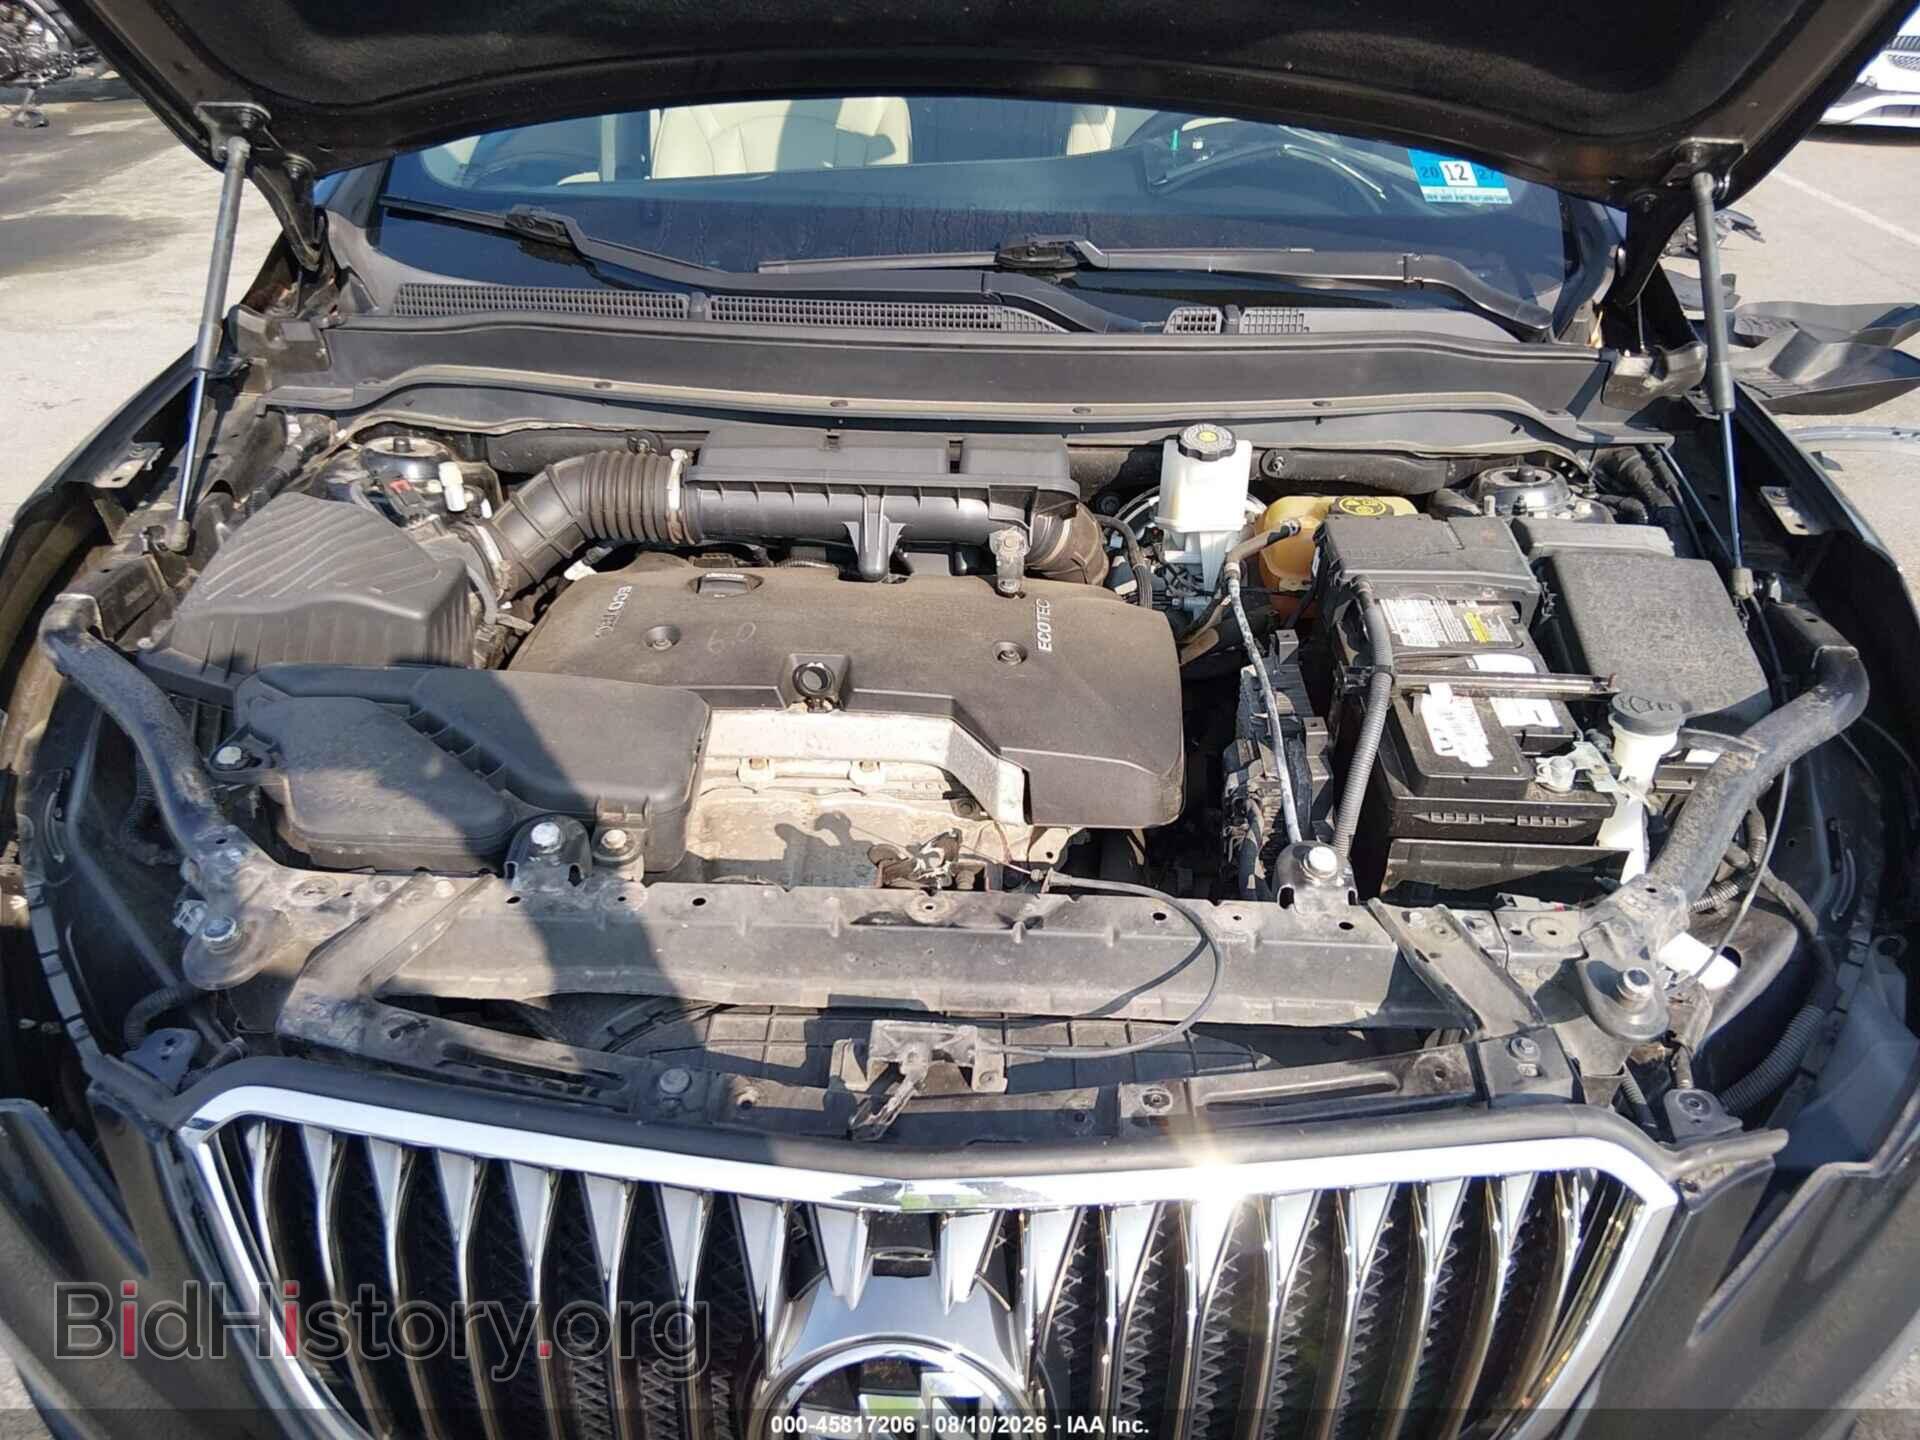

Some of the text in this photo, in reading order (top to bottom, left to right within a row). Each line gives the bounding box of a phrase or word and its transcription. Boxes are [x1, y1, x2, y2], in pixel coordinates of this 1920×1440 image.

[1422, 167, 1440, 179] 20
[1445, 164, 1469, 181] 12
[1036, 598, 1052, 652] ECOTEC
